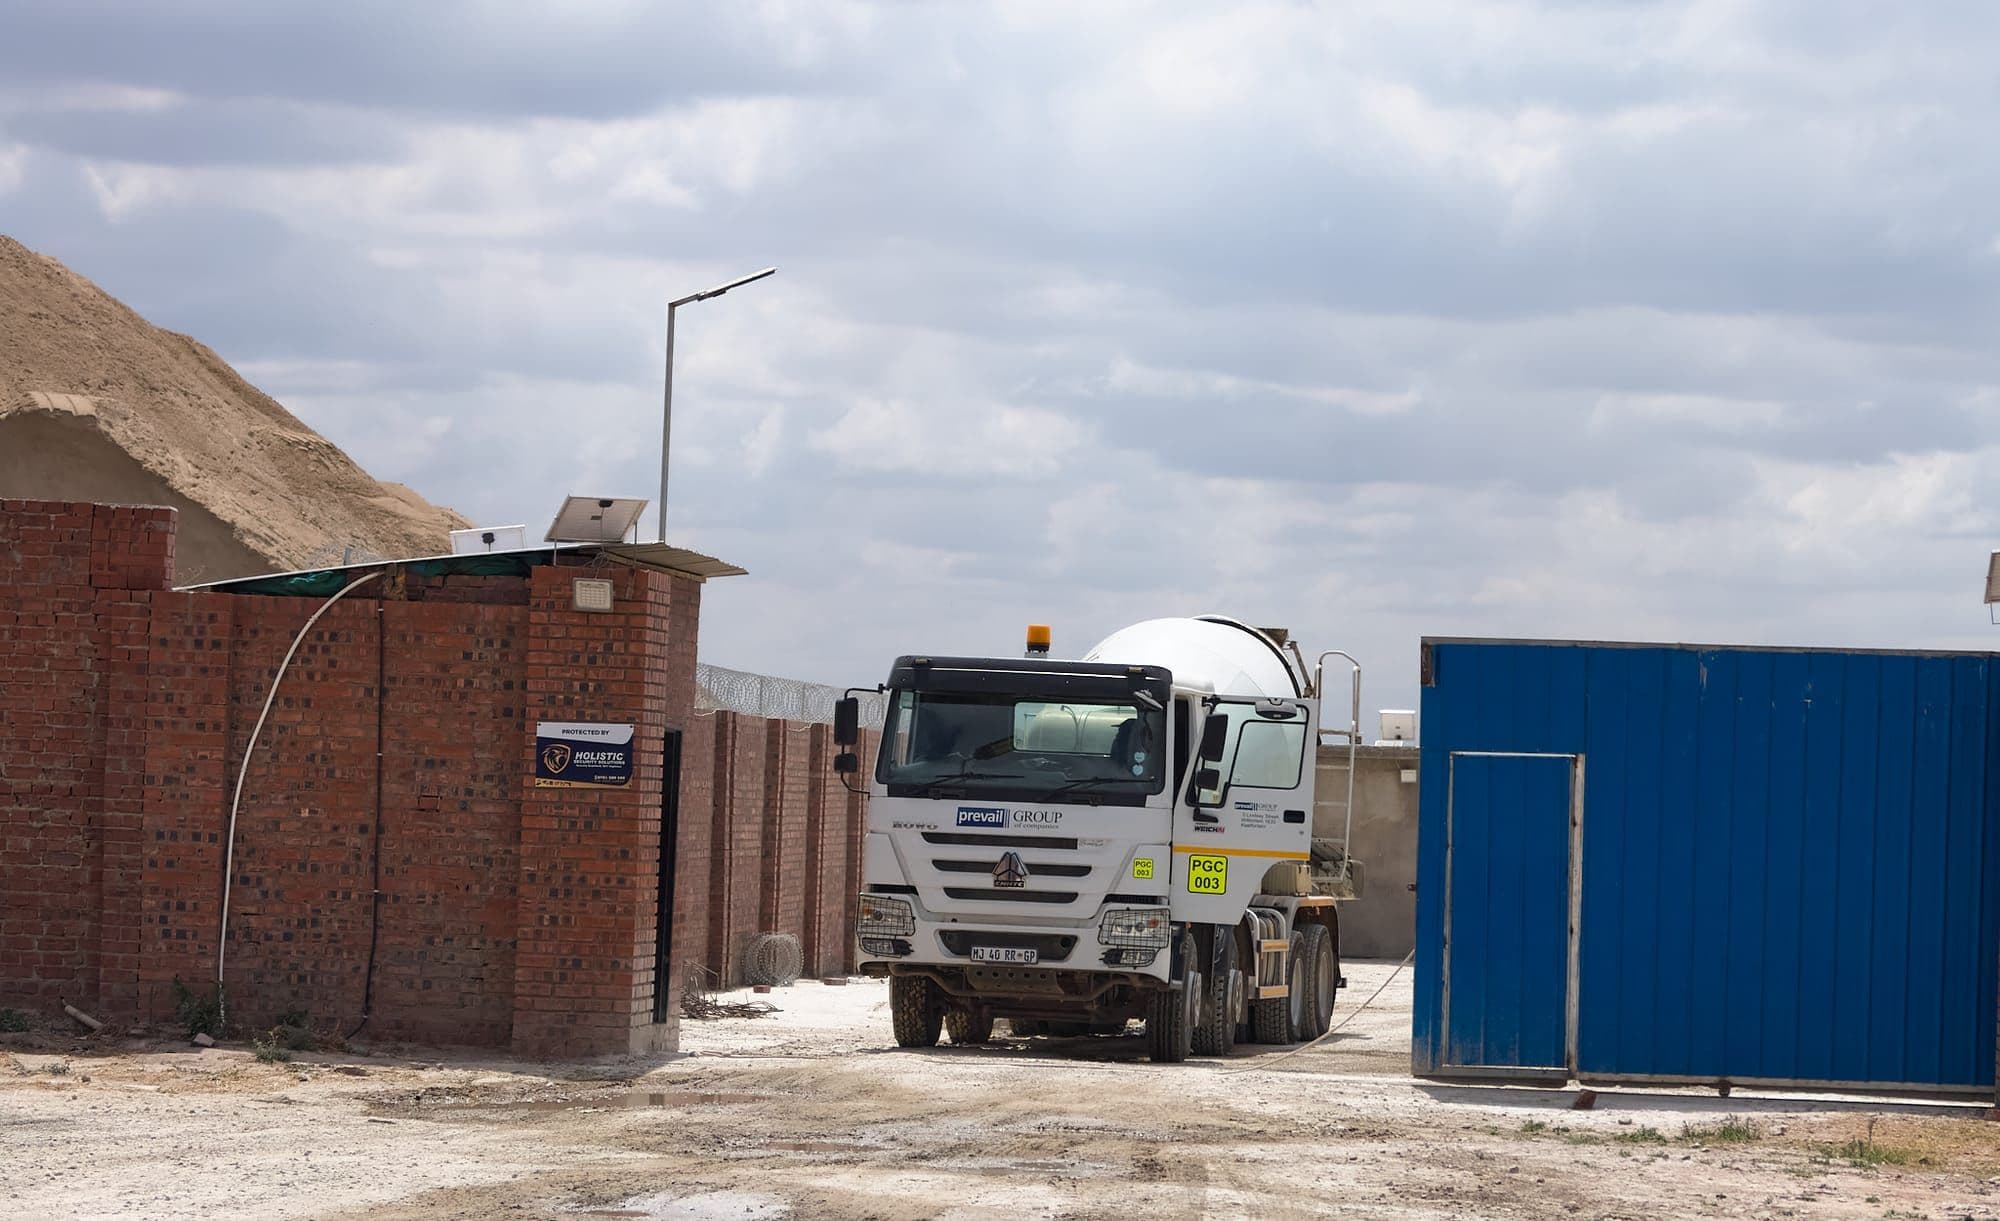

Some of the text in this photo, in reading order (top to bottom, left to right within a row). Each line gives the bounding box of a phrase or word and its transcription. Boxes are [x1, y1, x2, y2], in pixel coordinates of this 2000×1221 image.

[575, 752, 624, 761] HOLISTIC
[959, 810, 1004, 824] prevail
[1013, 810, 1063, 823] GROUP
[1192, 860, 1224, 873] PGC
[1194, 877, 1220, 889] 003
[989, 949, 1001, 961] 40
[1004, 949, 1017, 961] RR
[1023, 950, 1036, 963] GP
